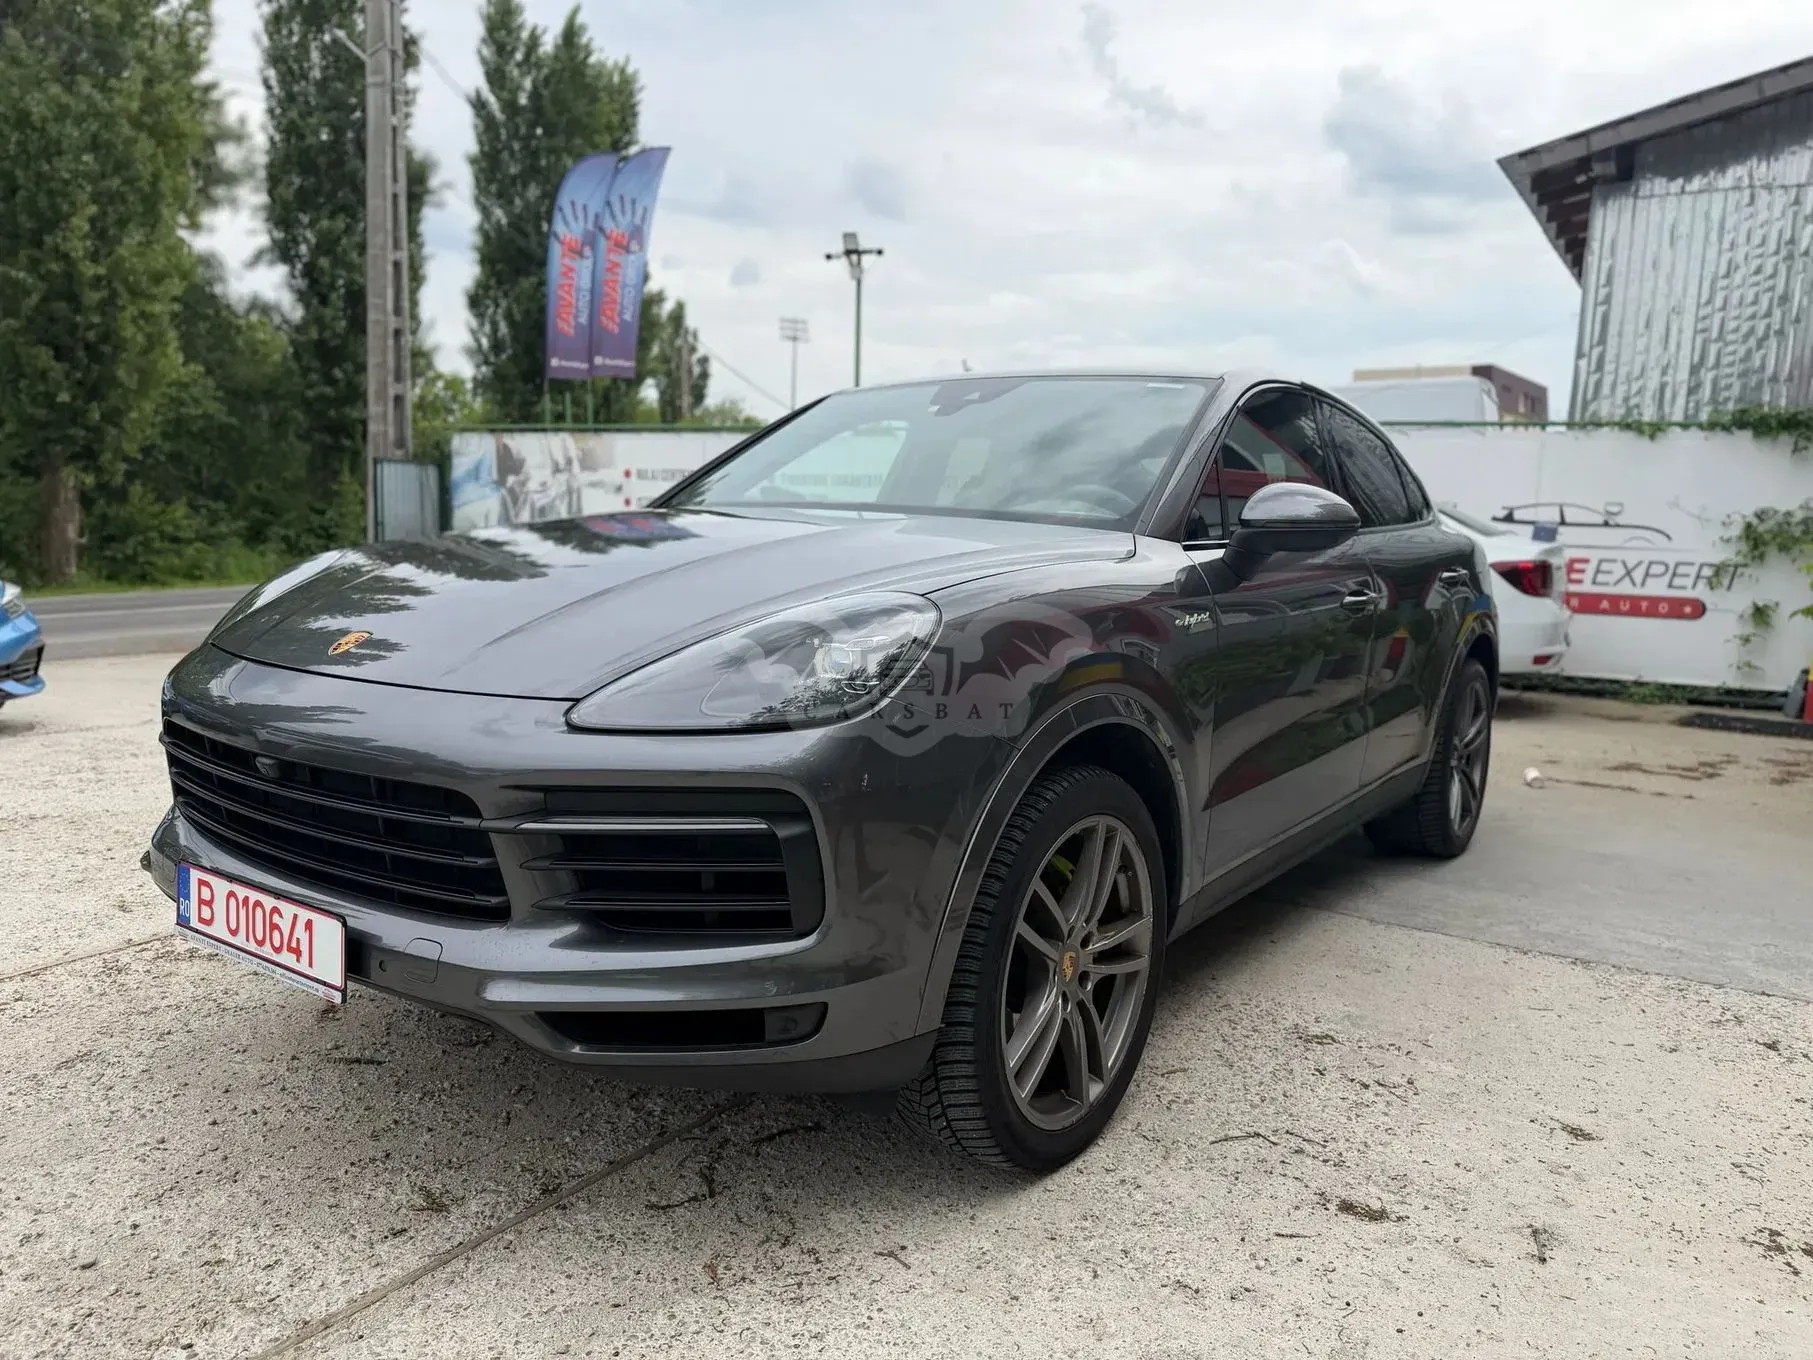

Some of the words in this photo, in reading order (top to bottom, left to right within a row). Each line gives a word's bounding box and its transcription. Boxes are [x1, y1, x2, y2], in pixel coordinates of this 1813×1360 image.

[1591, 558, 1749, 591] EXPERT
[1599, 599, 1669, 613] AUTO
[179, 899, 190, 918] RO
[197, 878, 215, 926] B
[225, 890, 313, 969] 010641
